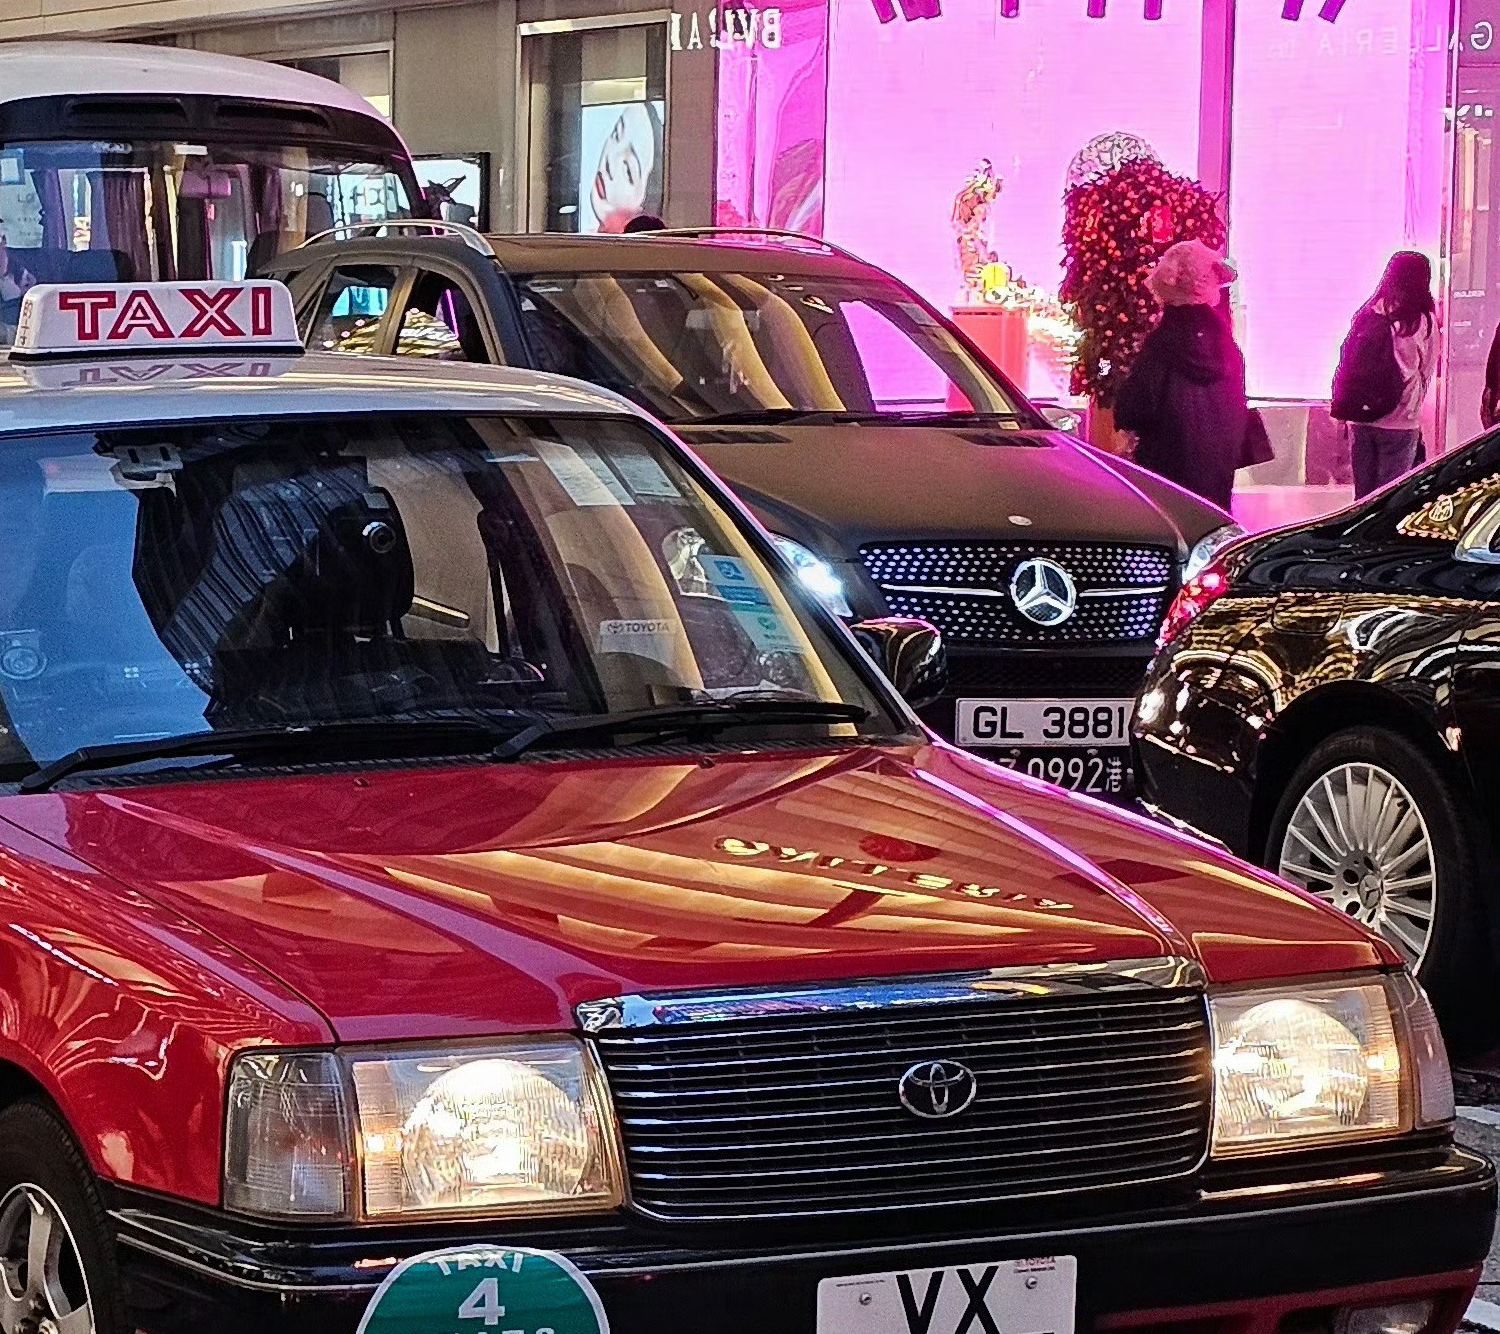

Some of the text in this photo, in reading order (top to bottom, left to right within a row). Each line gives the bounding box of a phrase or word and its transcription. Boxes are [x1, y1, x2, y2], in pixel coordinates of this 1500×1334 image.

[58, 286, 273, 341] TAXI
[625, 622, 669, 633] TOYOTA
[973, 706, 1125, 739] GL 3881
[432, 1251, 524, 1276] TAXI
[457, 1277, 506, 1326] 4
